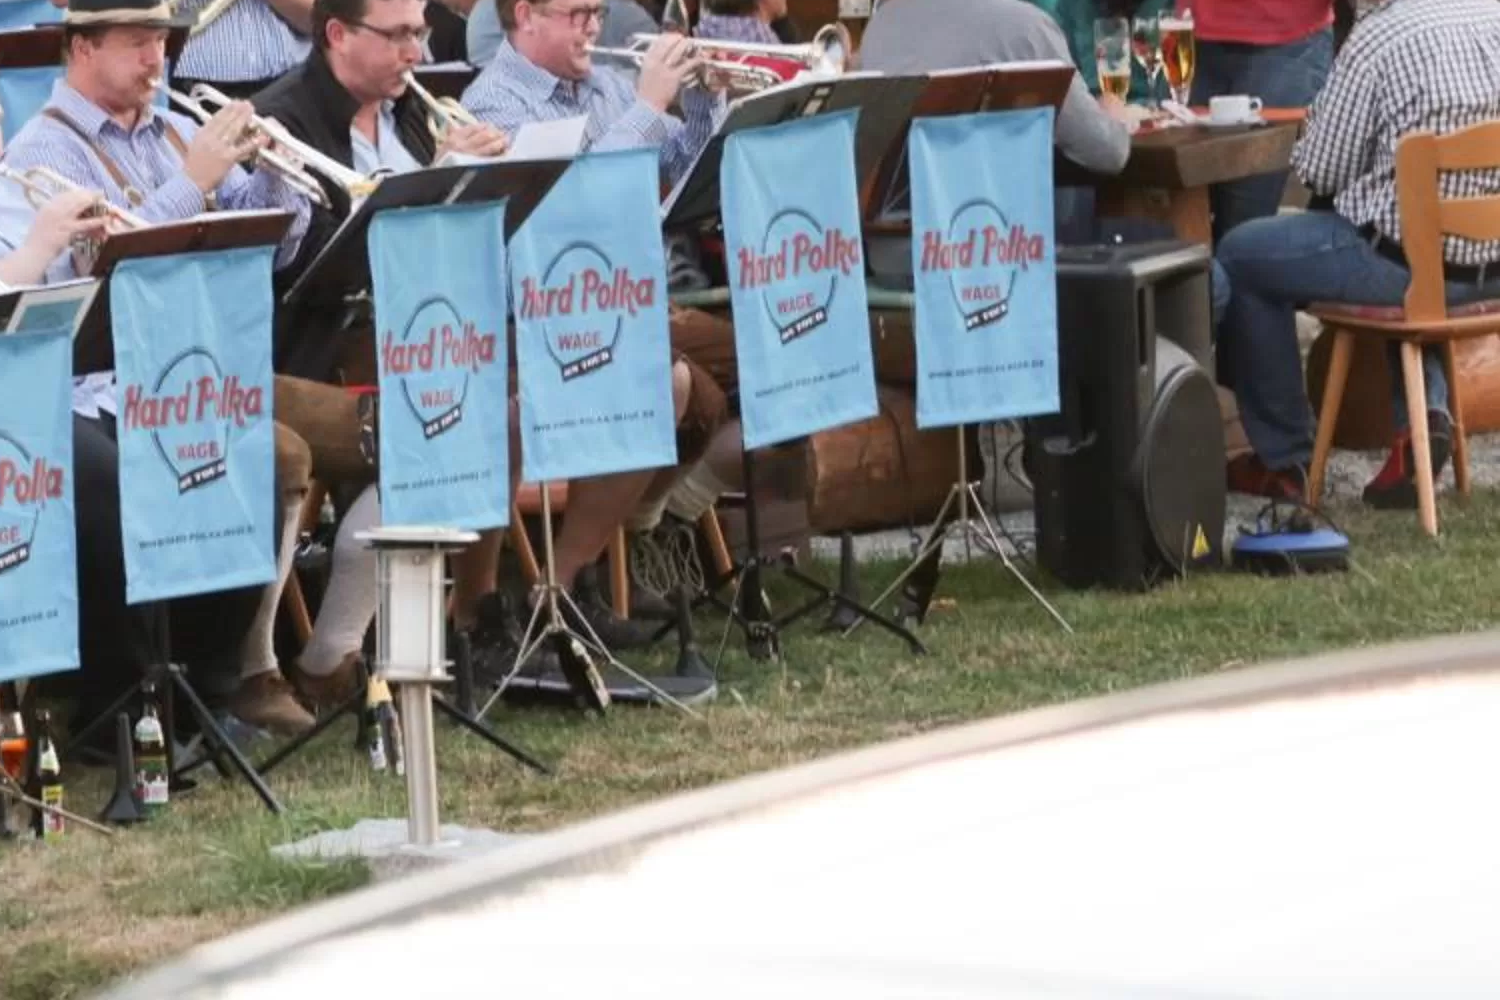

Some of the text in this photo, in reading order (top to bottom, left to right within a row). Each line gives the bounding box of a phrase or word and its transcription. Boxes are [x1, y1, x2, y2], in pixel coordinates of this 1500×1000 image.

[738, 228, 859, 290] Hard Polka
[921, 223, 1044, 273] Hard Polka
[581, 266, 655, 316] Polka
[440, 322, 496, 374] Polka
[557, 331, 602, 351] WAGE
[123, 380, 191, 433] Hard
[176, 441, 219, 460] WAGE
